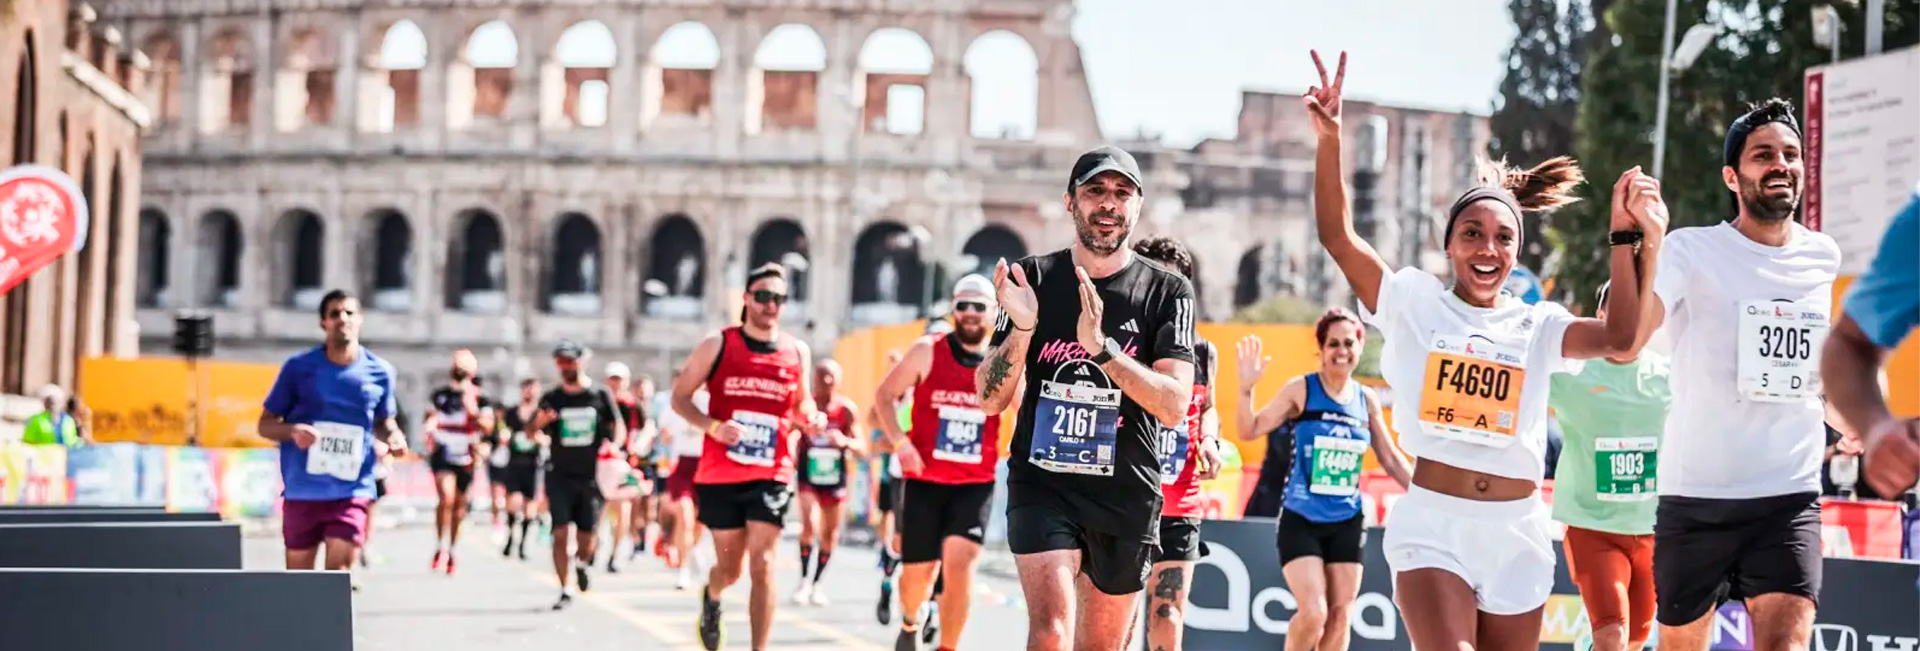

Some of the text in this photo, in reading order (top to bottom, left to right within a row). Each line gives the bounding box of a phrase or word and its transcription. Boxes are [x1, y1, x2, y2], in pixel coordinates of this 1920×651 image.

[1759, 325, 1811, 360] 3205
[1436, 359, 1511, 401] F4690
[1761, 373, 1802, 389] 5 D
[1052, 405, 1098, 437] 2161
[1437, 407, 1488, 428] F6 A
[1048, 446, 1091, 463] 3 C
[1160, 430, 1177, 455] 16
[1609, 452, 1645, 476] 1903
